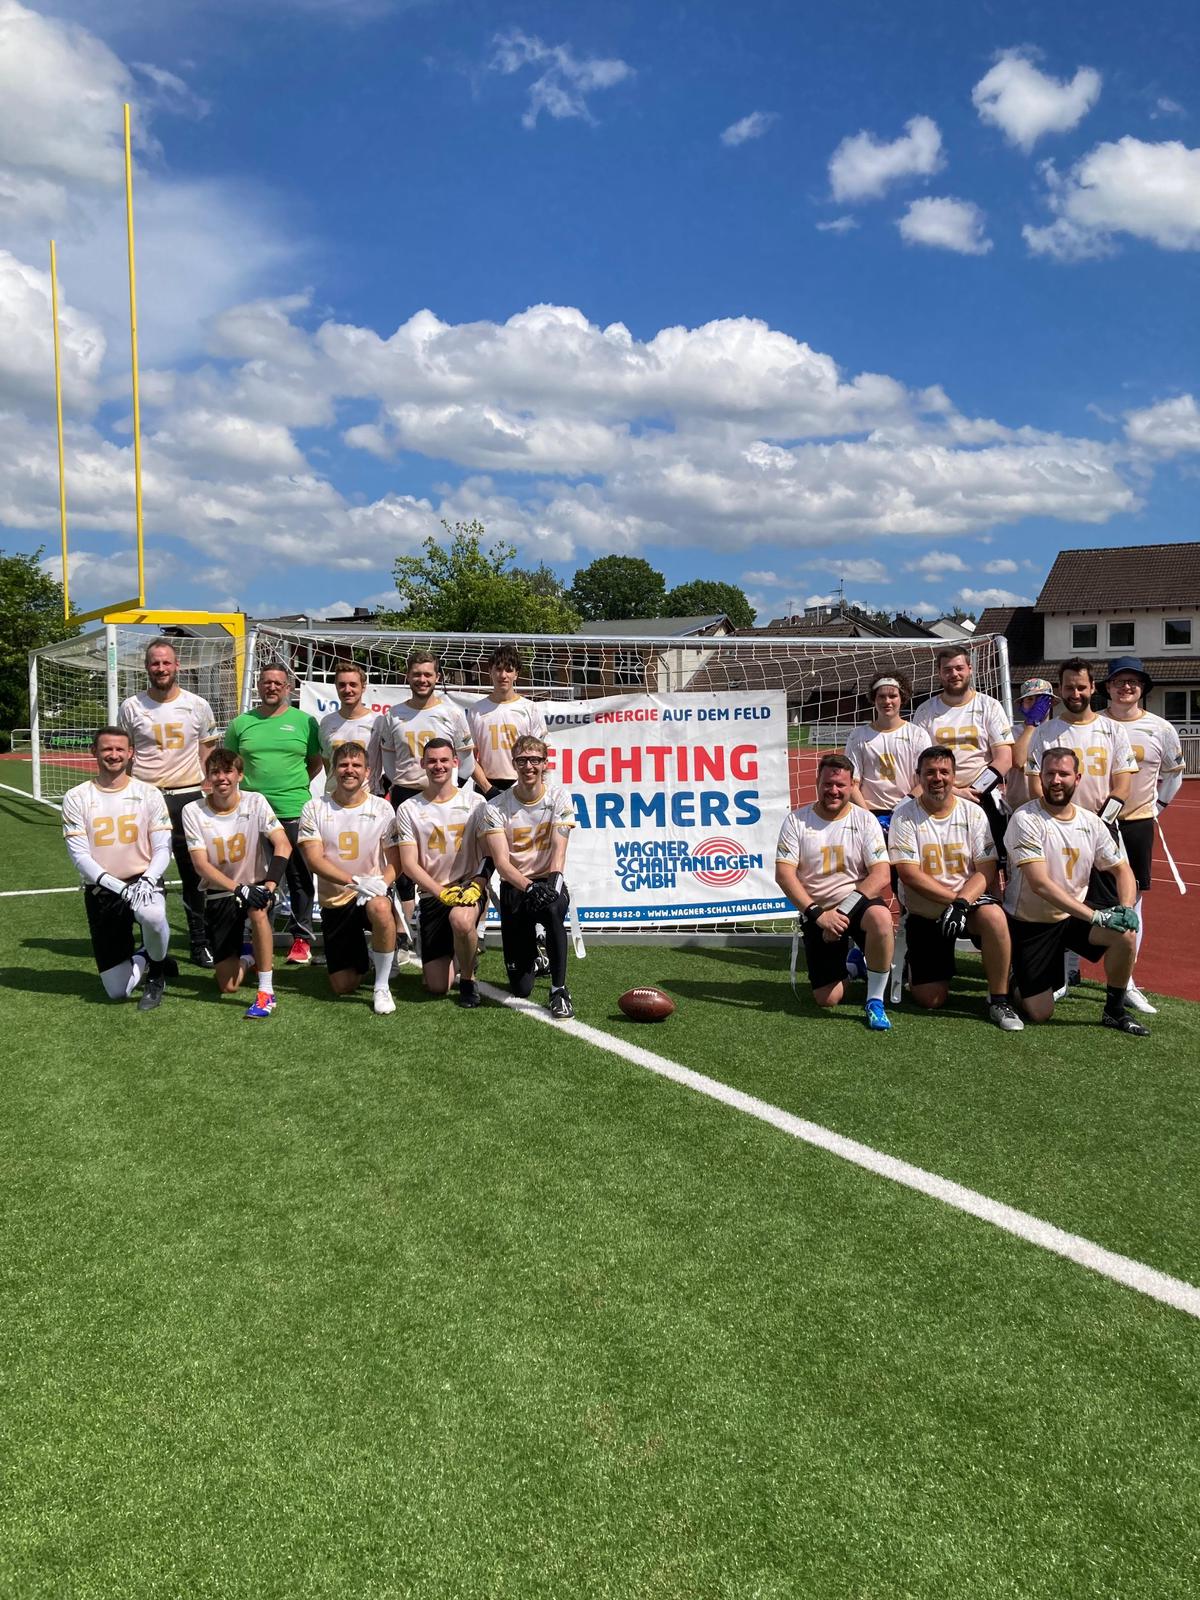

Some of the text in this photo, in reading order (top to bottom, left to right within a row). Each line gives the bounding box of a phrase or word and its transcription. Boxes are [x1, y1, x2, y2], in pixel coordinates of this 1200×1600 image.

[544, 706, 771, 726] VOLLE ENERGIE AUF DEM FELD
[152, 723, 186, 751] 15
[572, 790, 762, 829] ARMERS
[92, 813, 139, 848] 26
[212, 832, 247, 865] 18
[338, 831, 360, 861] 9
[614, 840, 689, 858] WAGNER
[820, 844, 845, 875] 11
[921, 842, 966, 875] 85
[614, 853, 763, 877] SCHALTANLAGEN
[1061, 847, 1080, 880] 7
[621, 873, 676, 892] GMBH
[584, 901, 786, 919] 02602 9432-0 WWW.WAGNER-SCHALTANLAGEN.DE
